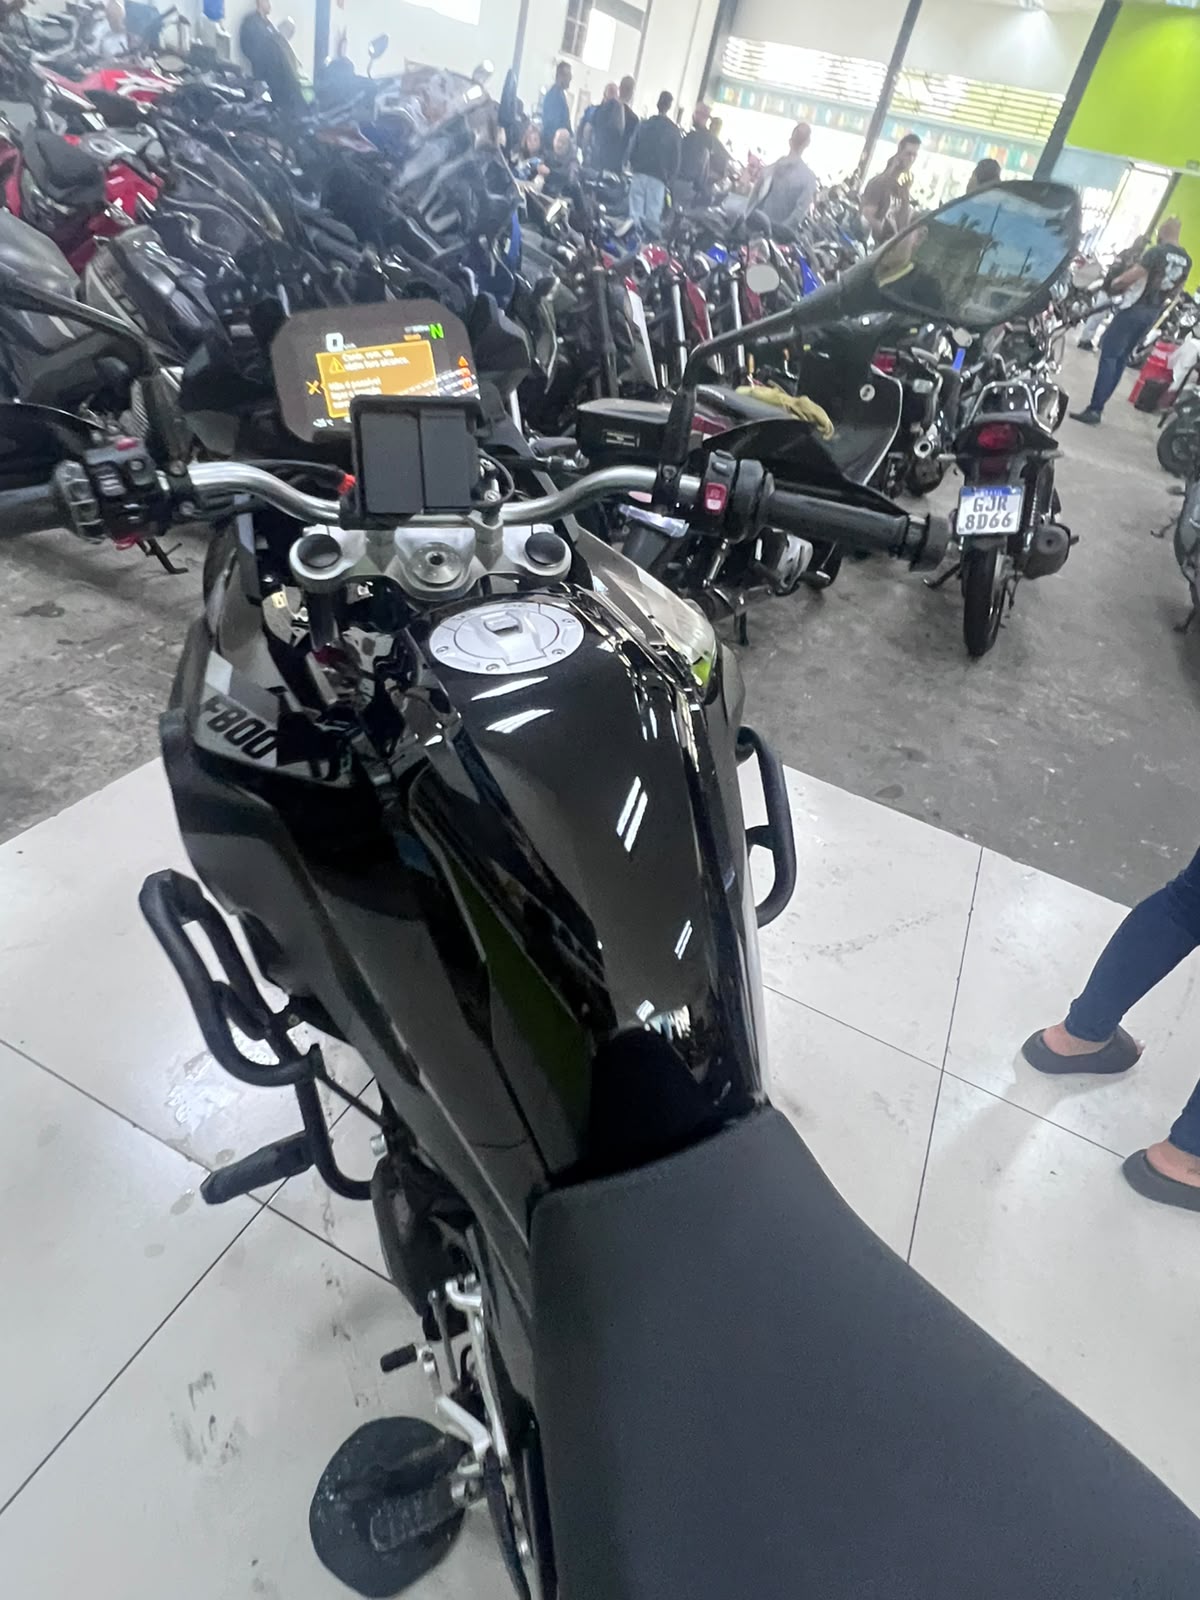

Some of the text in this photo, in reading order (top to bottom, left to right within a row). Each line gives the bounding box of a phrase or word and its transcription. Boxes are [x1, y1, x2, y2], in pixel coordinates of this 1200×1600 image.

[429, 323, 444, 339] N
[973, 496, 1008, 512] GJR
[965, 512, 1012, 530] 8D66
